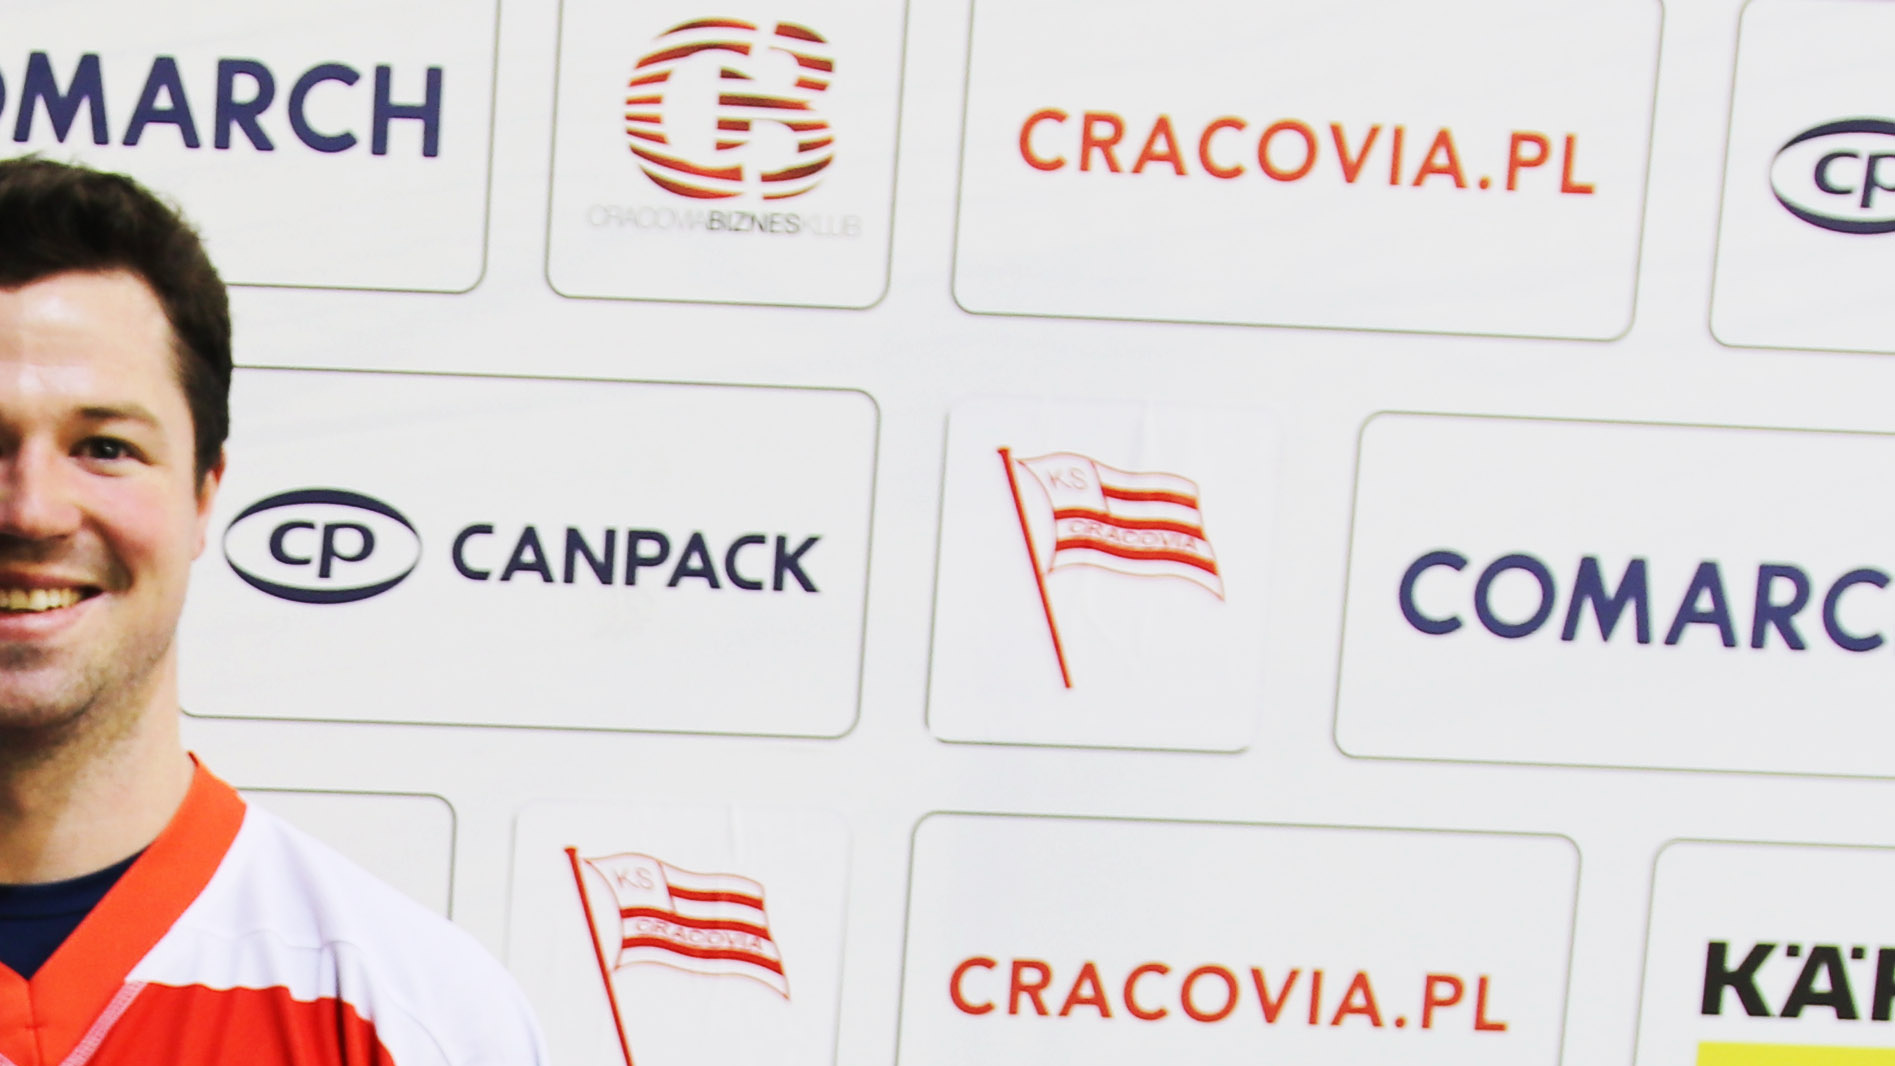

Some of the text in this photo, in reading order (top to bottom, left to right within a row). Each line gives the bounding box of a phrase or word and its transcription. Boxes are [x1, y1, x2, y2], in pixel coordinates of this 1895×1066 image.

[1019, 108, 1595, 195] CRACOVIA.PL
[451, 522, 822, 593] CANPACK
[949, 956, 1508, 1032] CRACOVIA.PL
